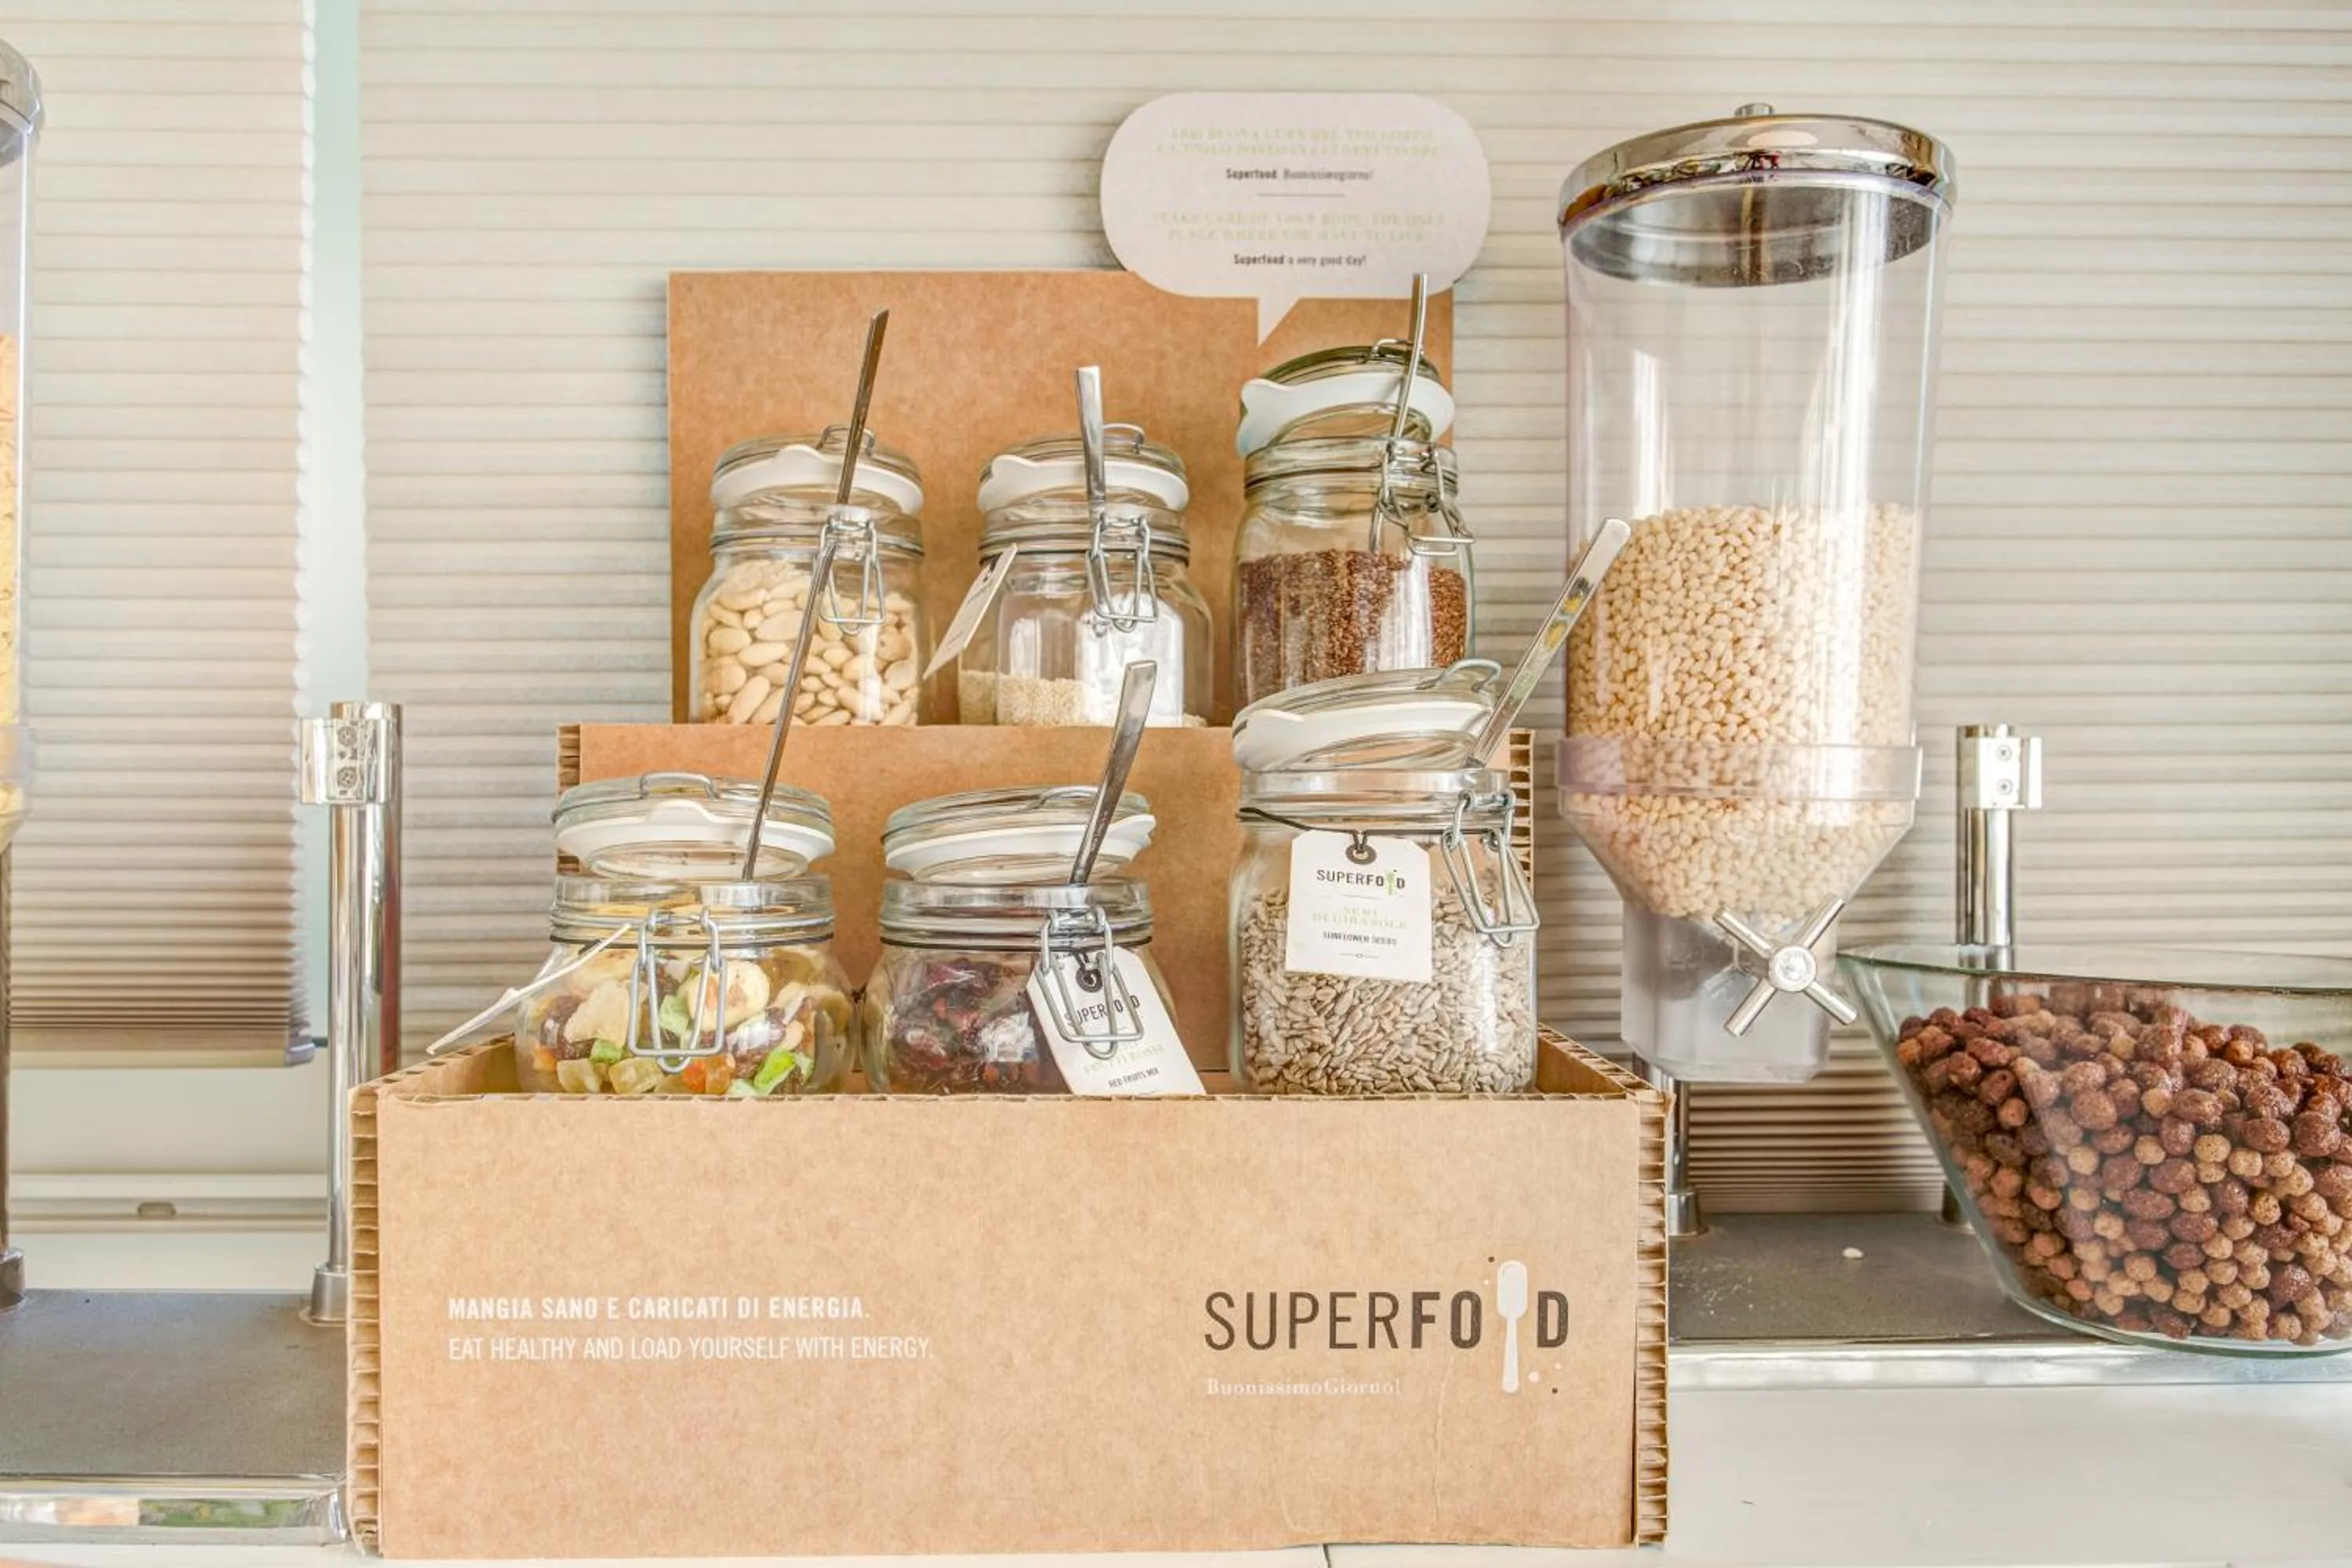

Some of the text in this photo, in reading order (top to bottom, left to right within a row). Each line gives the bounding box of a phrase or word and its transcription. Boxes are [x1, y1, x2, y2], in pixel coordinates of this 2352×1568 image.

[1234, 253, 1284, 267] Superfood
[1296, 257, 1317, 268] very
[1320, 255, 1343, 268] good
[1108, 1076, 1123, 1088] RED
[448, 1296, 870, 1320] MANGIA SANO E CARICATI DI ENERGIA.
[448, 1335, 935, 1360] EAT HEALTHY AND LOAD YOURSELF WITH ENERGY.
